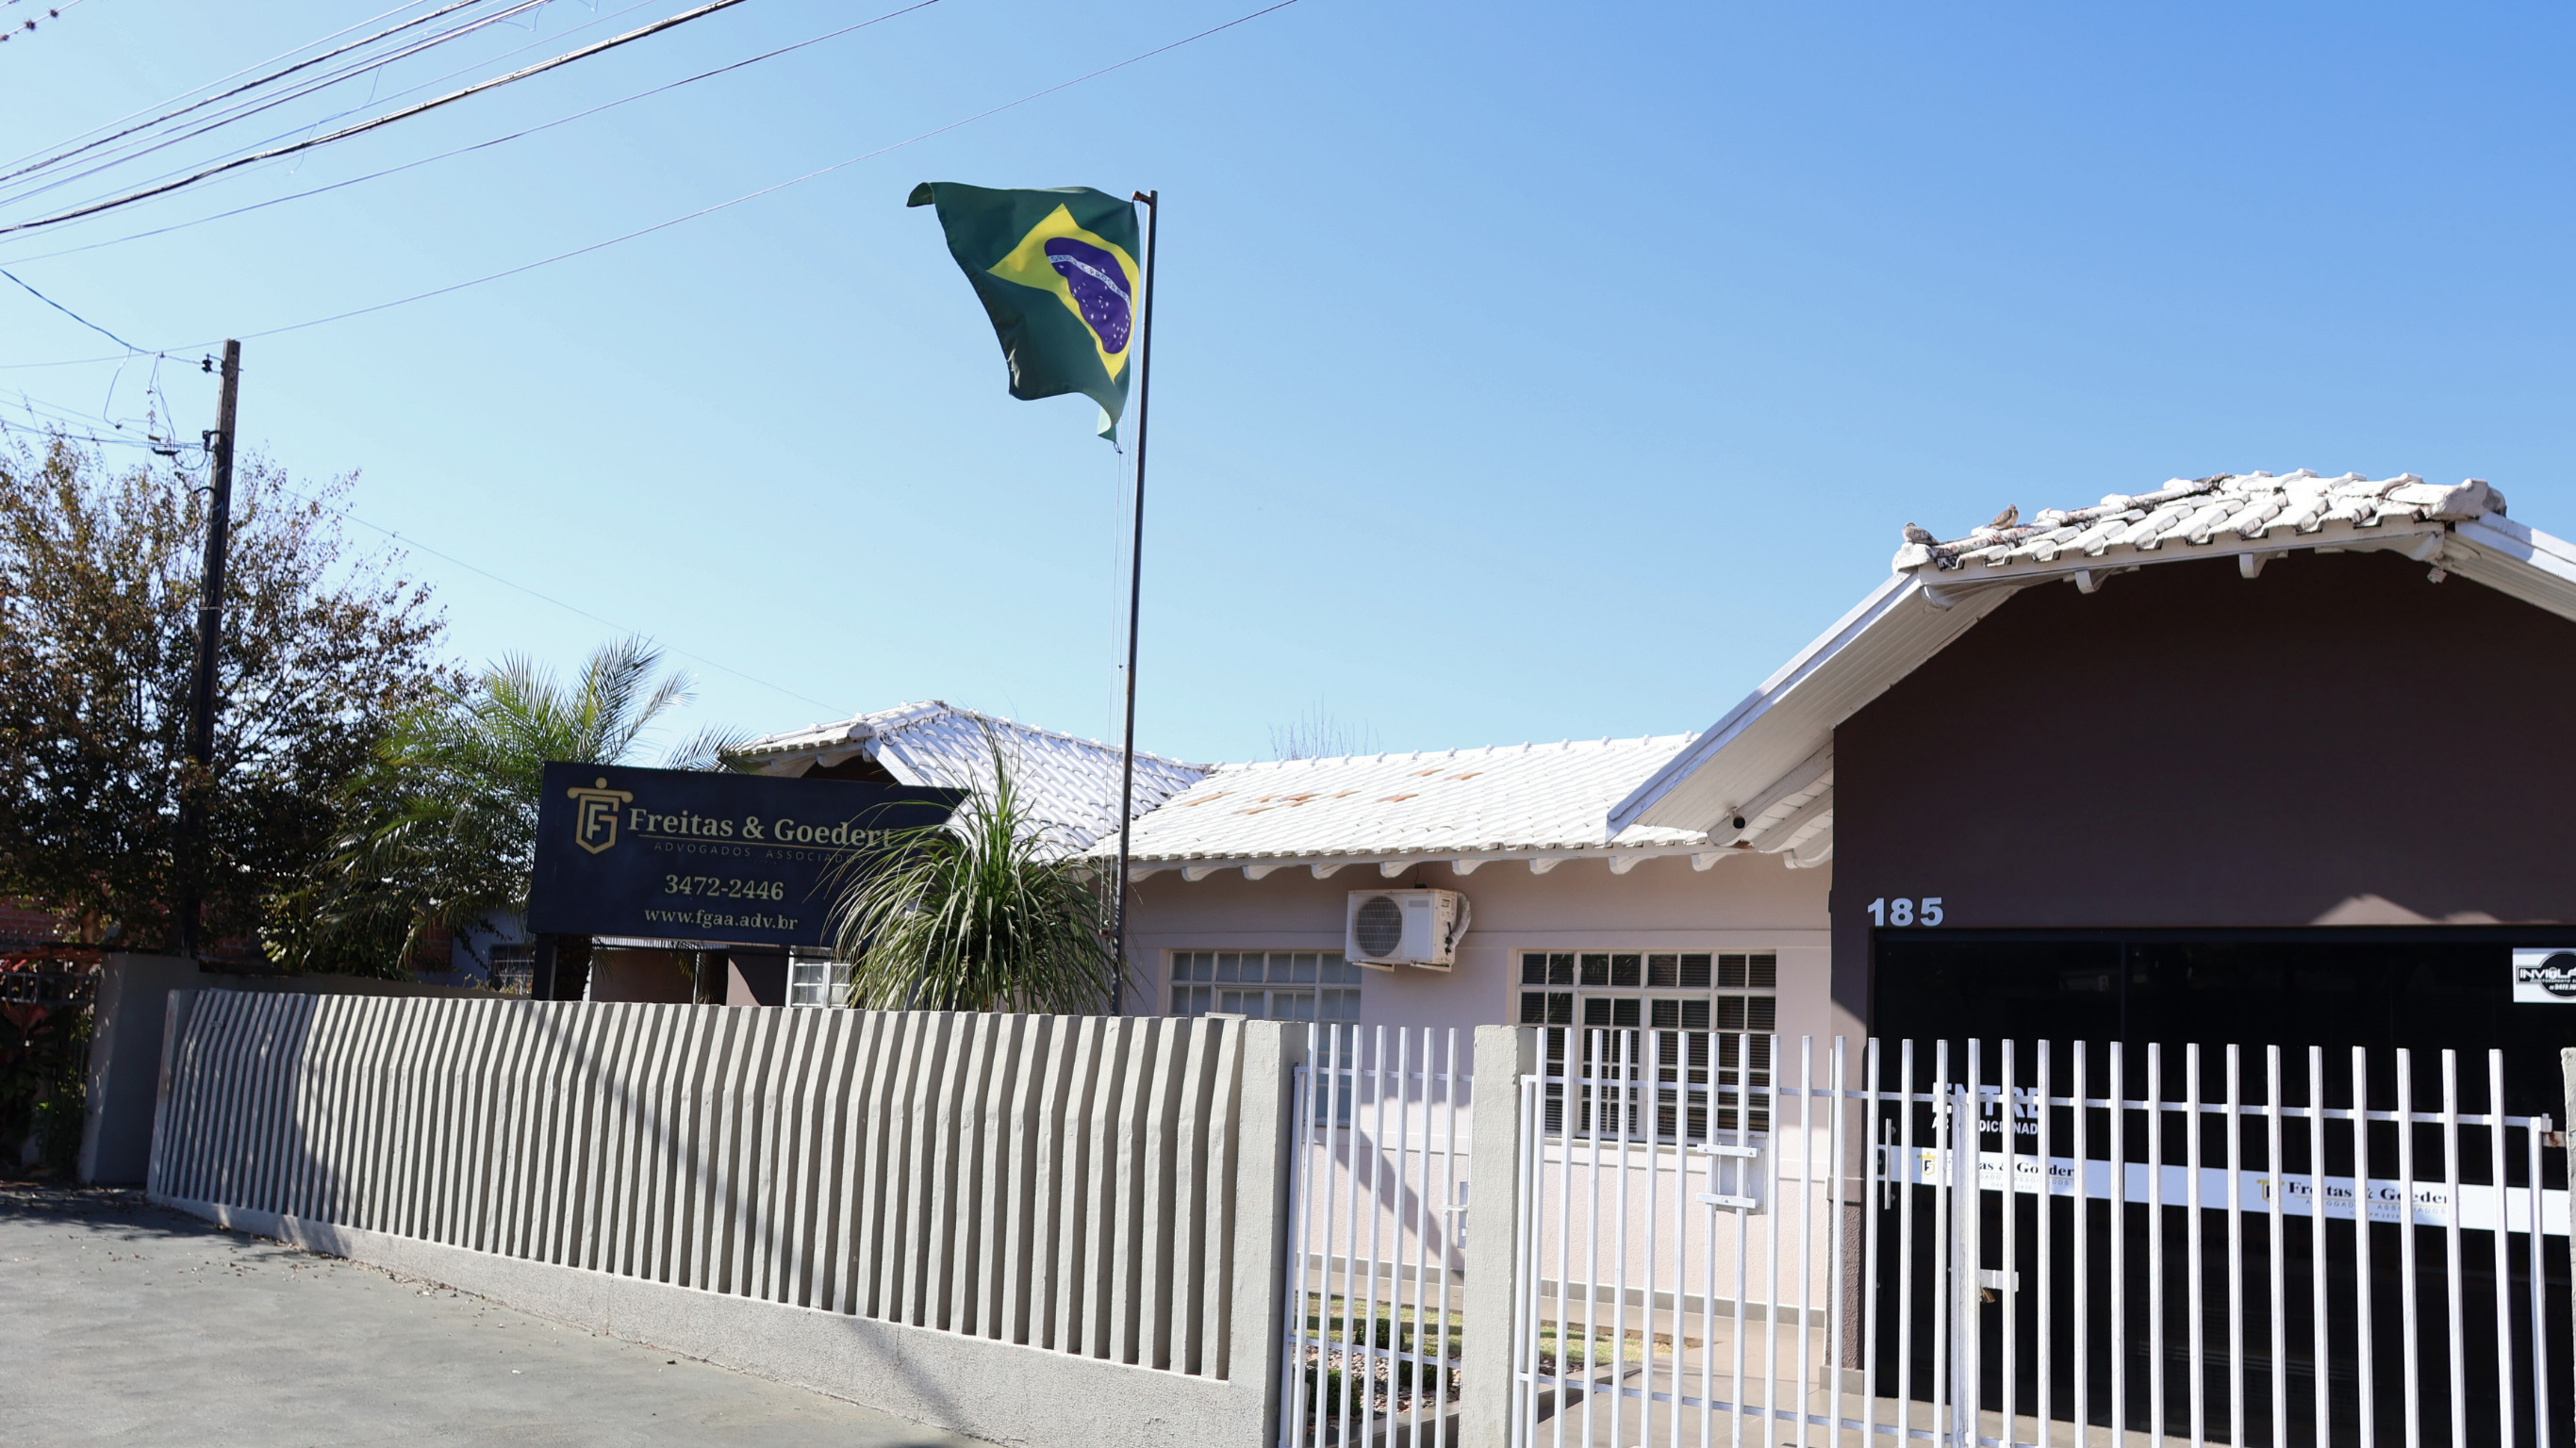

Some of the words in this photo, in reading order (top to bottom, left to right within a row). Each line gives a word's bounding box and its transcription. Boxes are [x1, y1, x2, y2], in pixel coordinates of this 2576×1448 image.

[627, 808, 734, 838] Freitas
[741, 815, 765, 840] &
[774, 818, 893, 848] Goedert
[653, 842, 751, 858] ADVOGADOS
[766, 848, 864, 864] ASSOCIADOS
[665, 875, 784, 901] 3472-2446
[644, 909, 799, 930] www.fgaa.adv.br
[1867, 897, 1944, 927] 185
